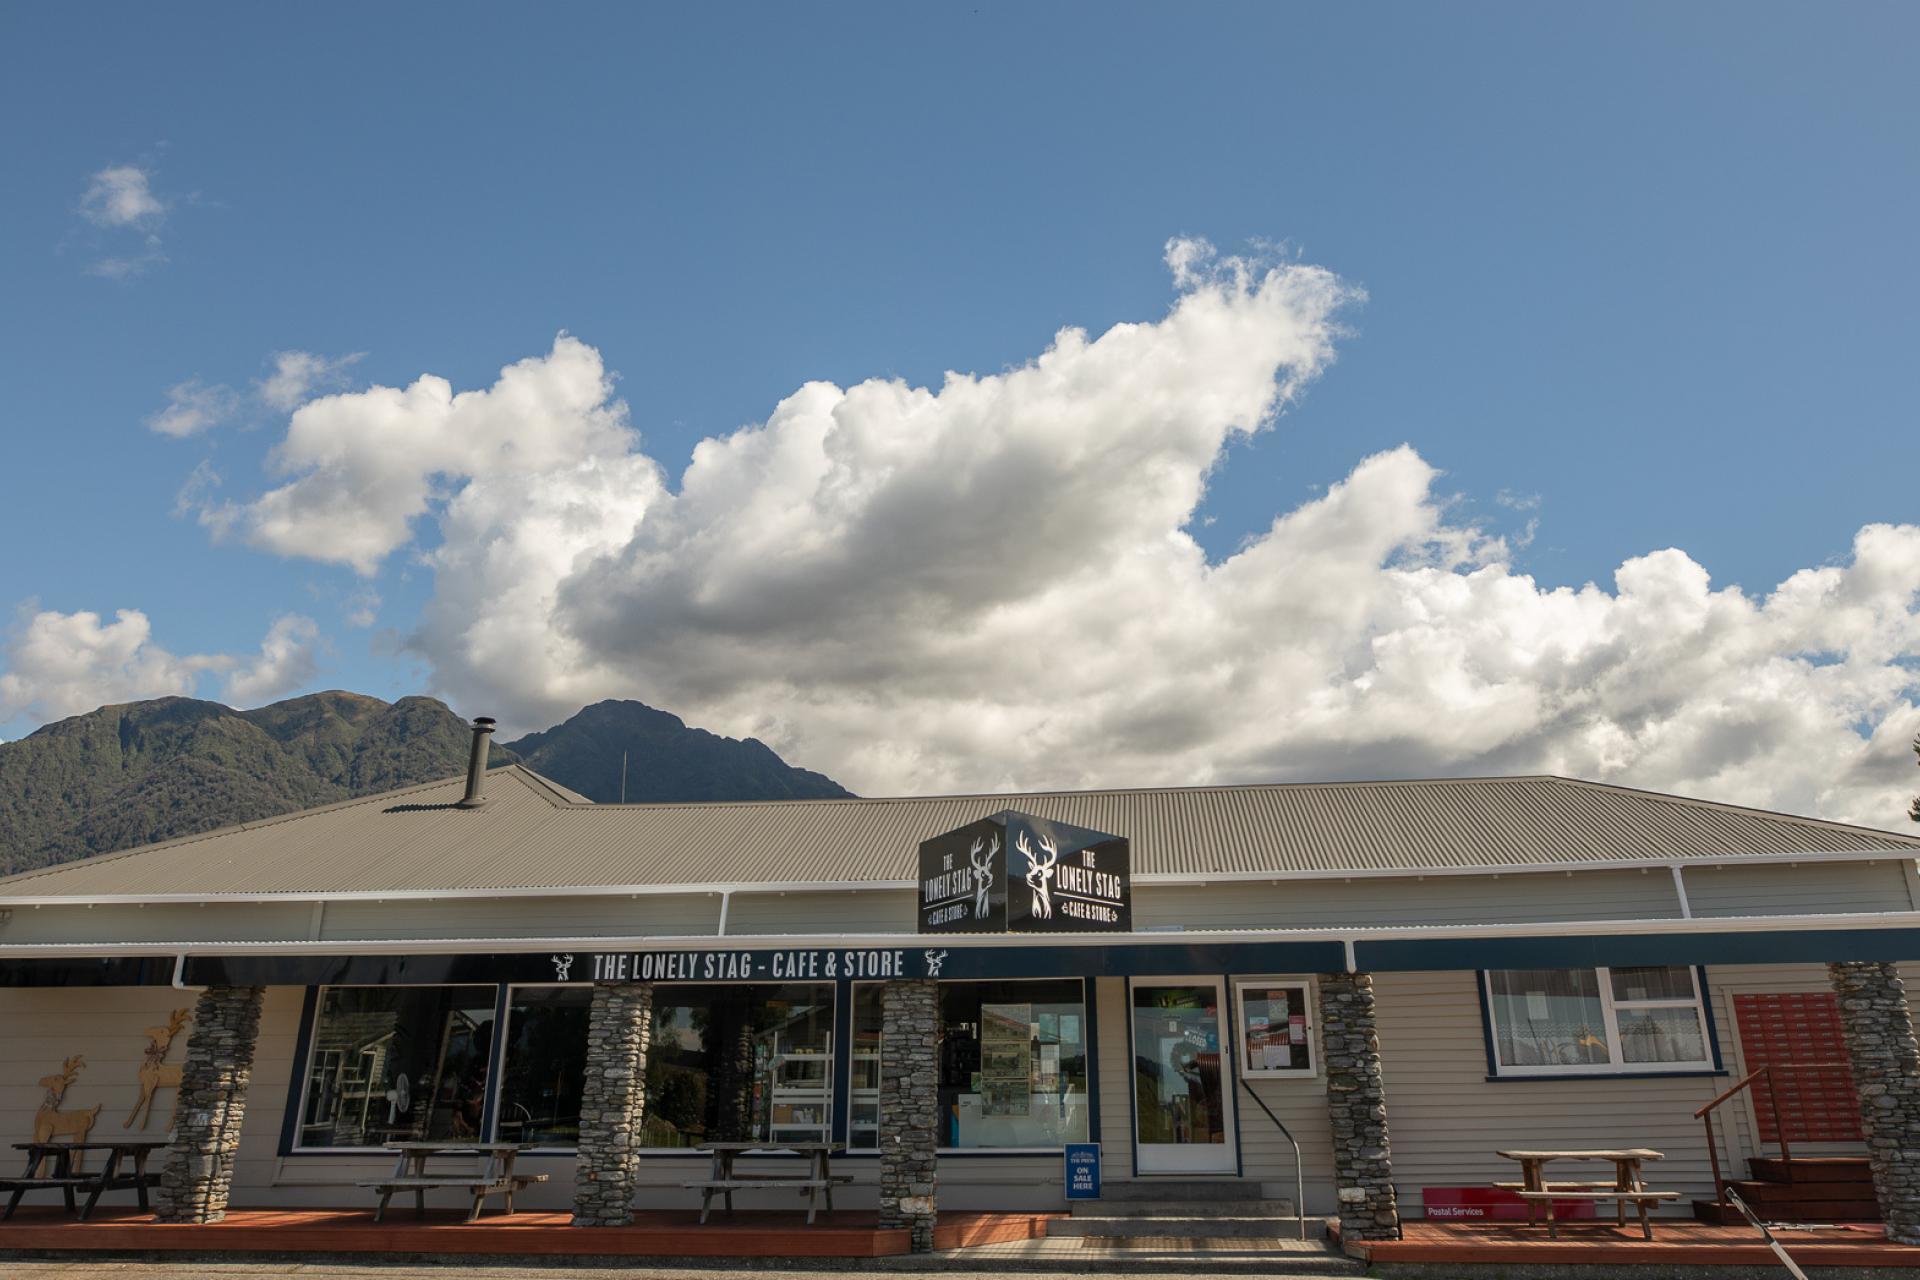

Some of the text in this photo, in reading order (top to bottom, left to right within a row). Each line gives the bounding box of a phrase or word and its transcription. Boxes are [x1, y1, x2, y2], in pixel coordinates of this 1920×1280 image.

[943, 853, 953, 871] THE
[1081, 849, 1096, 869] THE
[925, 866, 972, 903] LONELY STAG
[1056, 863, 1122, 900] LONELY STAG
[932, 909, 944, 926] CAFE
[948, 904, 964, 921] STORE
[1069, 903, 1111, 923] CAFE & STORE
[594, 953, 627, 980] THE
[632, 953, 698, 980] LONELY
[704, 952, 751, 979] STAG
[772, 951, 818, 978] CAFE
[824, 952, 837, 977] &
[843, 950, 904, 977] STORE
[1428, 1207, 1484, 1216] Postal Services
